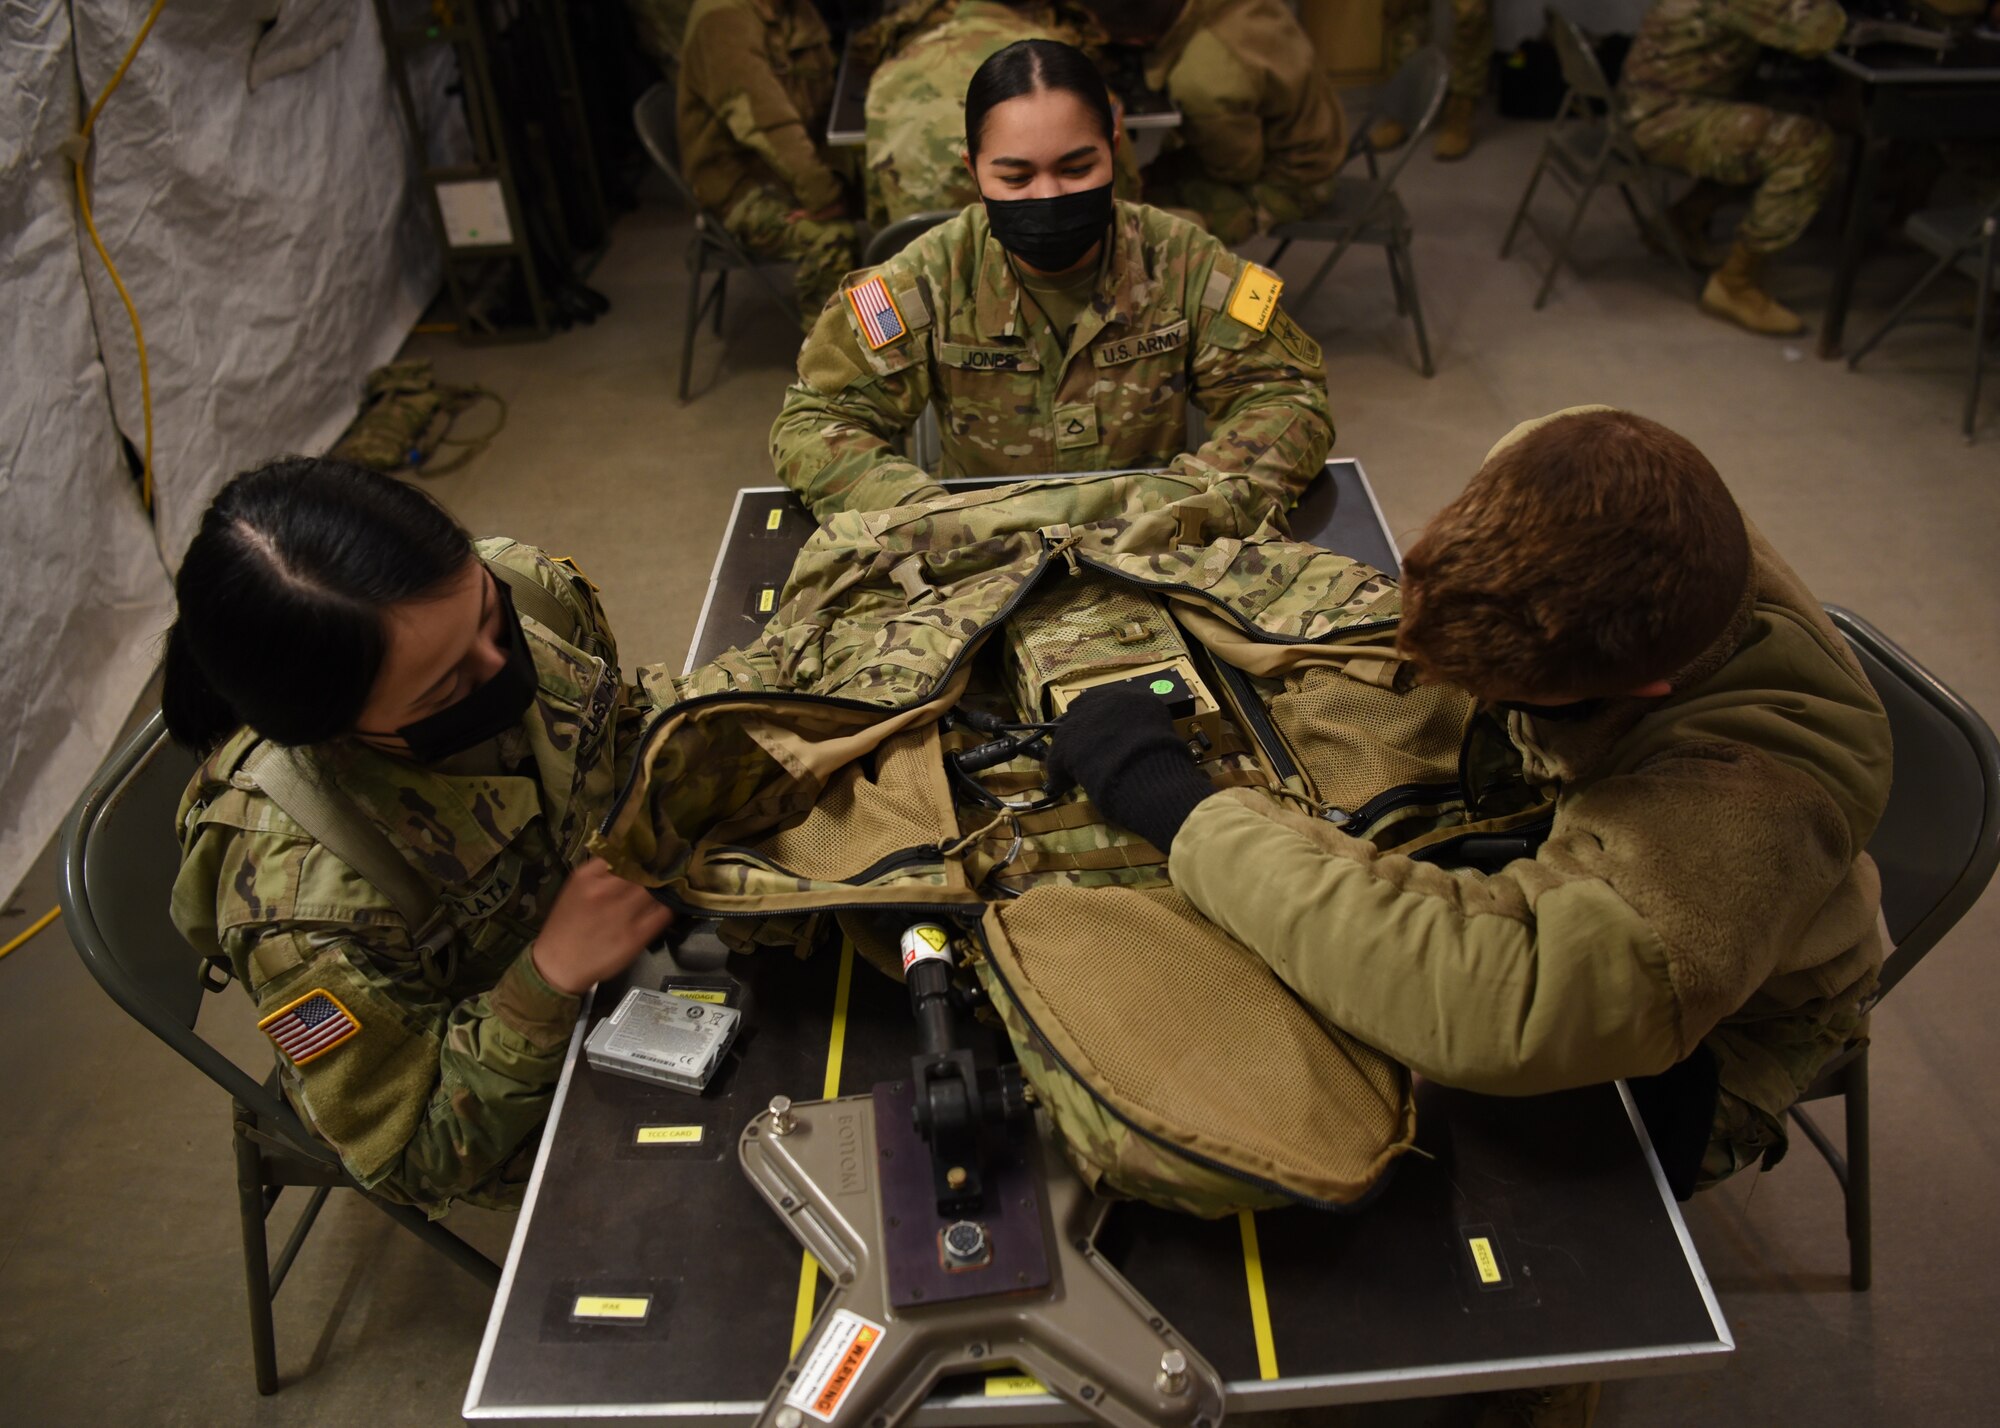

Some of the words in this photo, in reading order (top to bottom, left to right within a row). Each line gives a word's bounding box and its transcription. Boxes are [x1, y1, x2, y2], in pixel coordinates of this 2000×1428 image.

[963, 351, 1015, 368] JONES
[1102, 345, 1131, 364] U.S.
[1136, 330, 1182, 356] ARMY
[455, 878, 511, 916] LATA
[819, 1344, 864, 1410] WARNING
